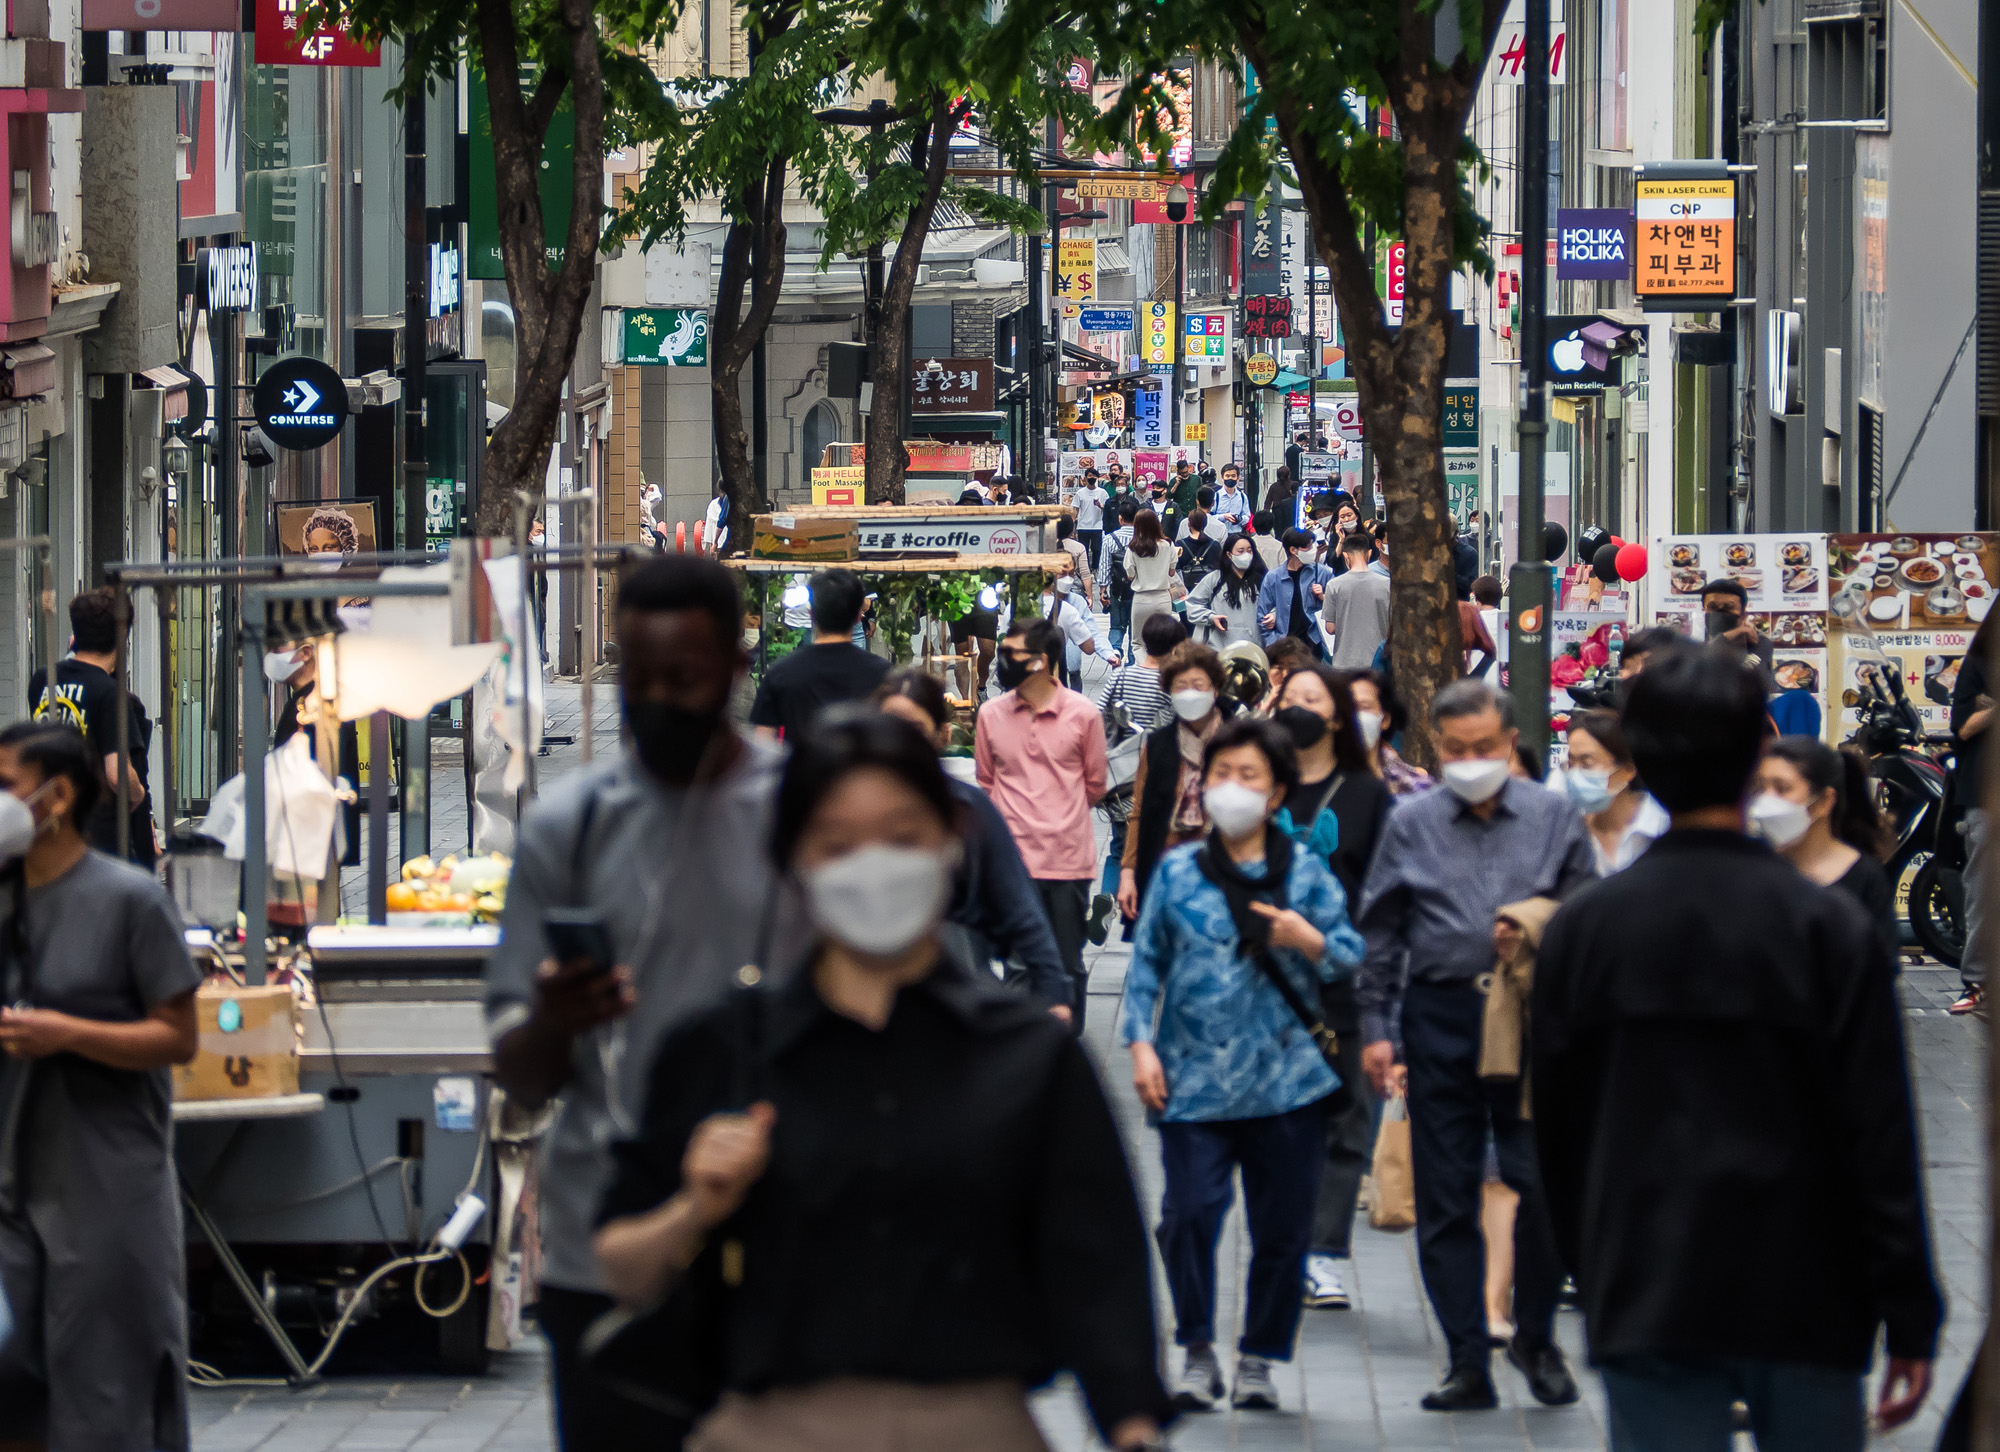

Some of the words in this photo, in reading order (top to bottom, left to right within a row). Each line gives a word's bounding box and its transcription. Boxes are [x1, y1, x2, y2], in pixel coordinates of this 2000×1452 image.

[302, 36, 334, 59] 4F
[1644, 187, 1665, 195] SKIN
[1668, 186, 1696, 194] LASER
[1699, 186, 1727, 194] CLINIC
[1670, 203, 1701, 215] CNP
[1563, 228, 1625, 245] HOLIKA
[1650, 224, 1722, 249] 차앤박
[1563, 244, 1625, 261] HOLIKA
[1650, 253, 1722, 276] 피부과
[1078, 272, 1092, 292] $
[1246, 296, 1290, 316] 明洞
[631, 313, 655, 328] 서민호
[1191, 318, 1202, 333] $
[1209, 319, 1222, 333] 元
[1189, 338, 1202, 353] €
[1209, 338, 1221, 353] ¥
[686, 355, 704, 363] Hair
[1248, 361, 1275, 373] 부동산
[1252, 373, 1272, 381] 플러스
[1574, 381, 1605, 390] Reseller
[269, 415, 334, 425] CONVERSE
[1446, 412, 1475, 428] 성형
[902, 531, 981, 547] #croffle
[992, 537, 1018, 545] TAKE
[1935, 634, 1966, 646] 9,000원
